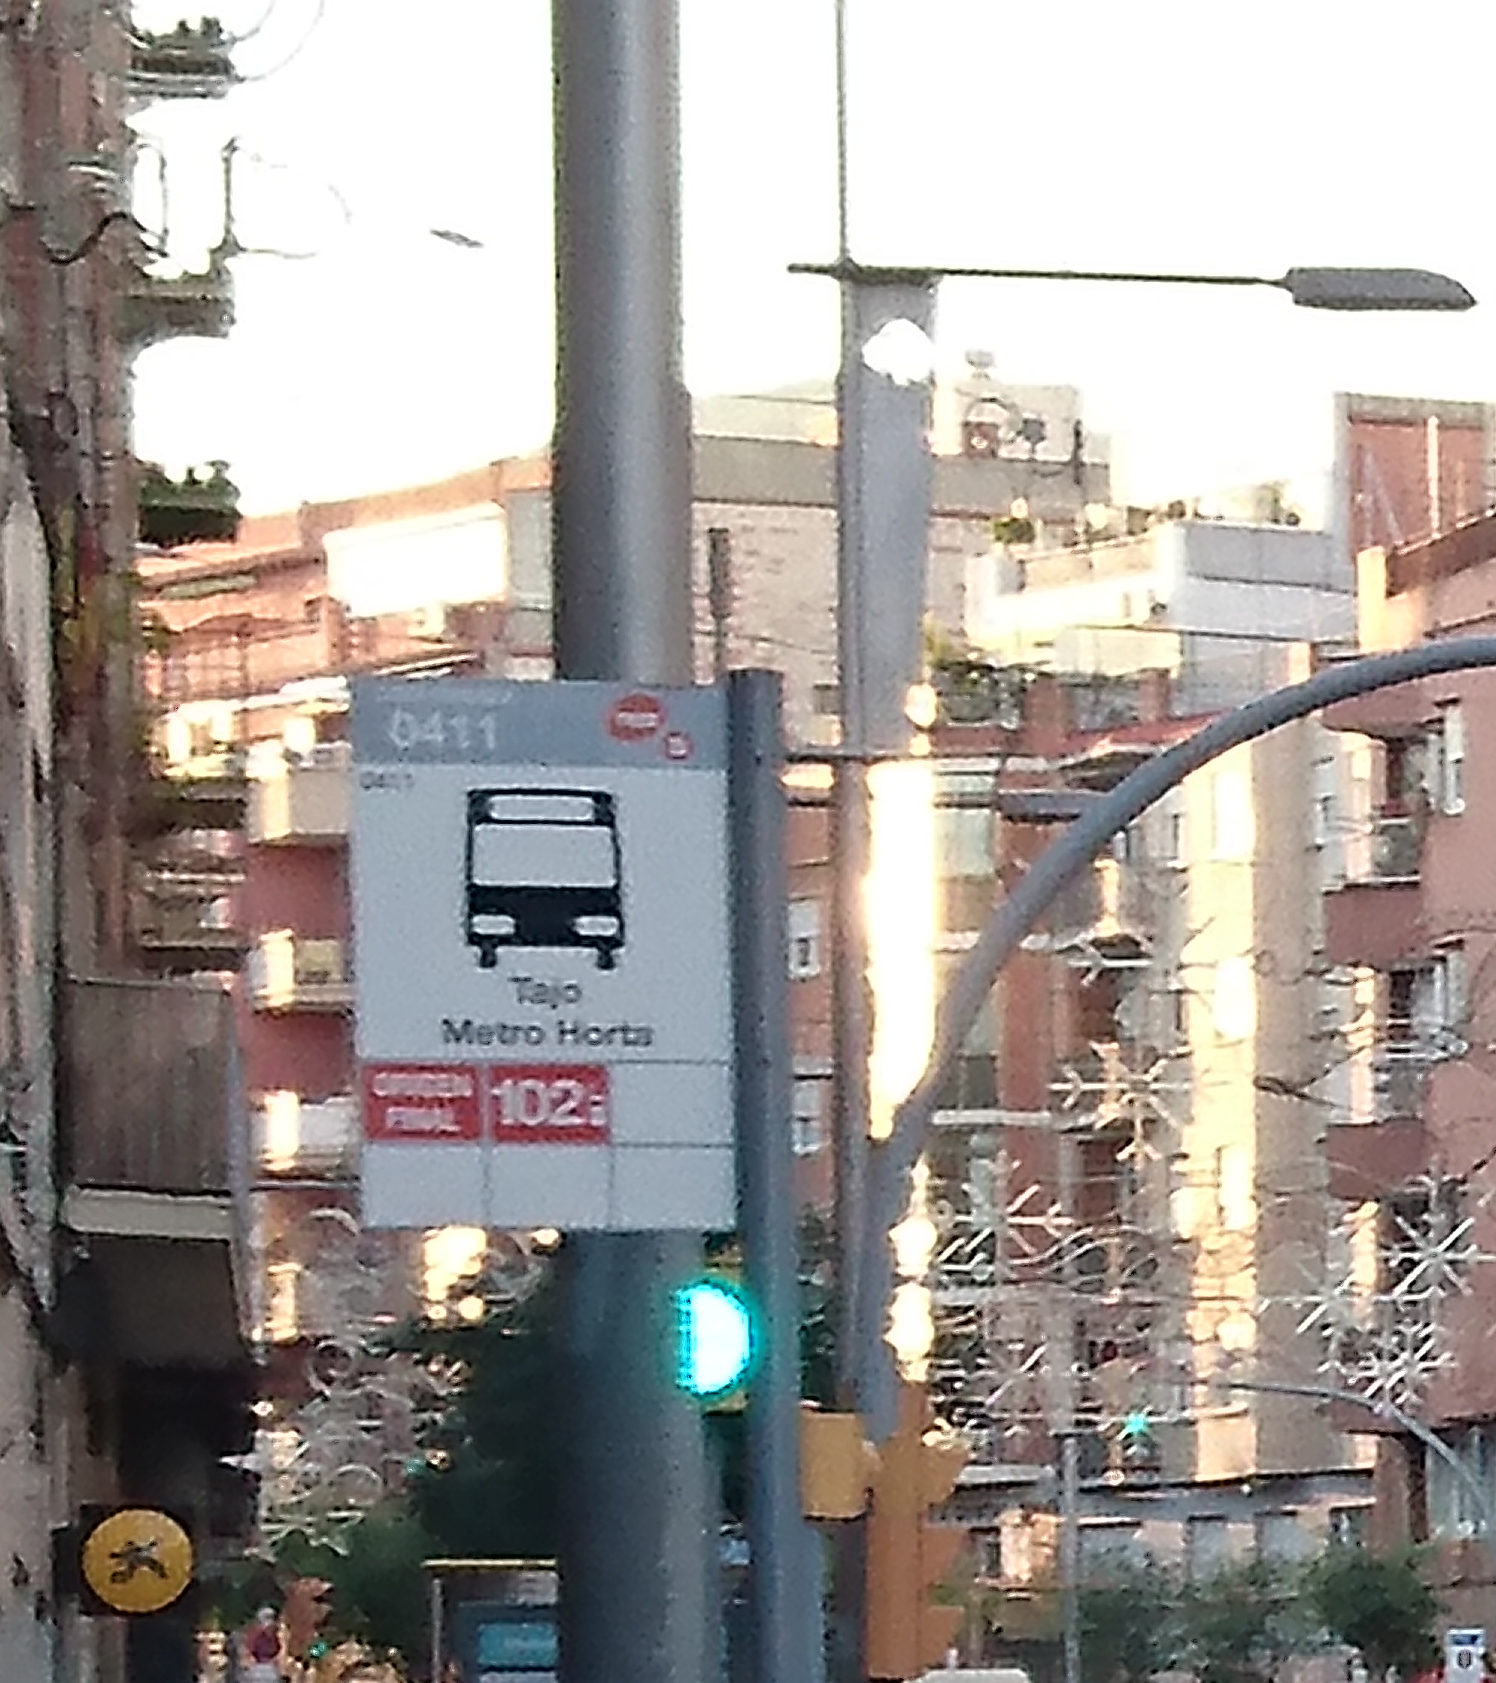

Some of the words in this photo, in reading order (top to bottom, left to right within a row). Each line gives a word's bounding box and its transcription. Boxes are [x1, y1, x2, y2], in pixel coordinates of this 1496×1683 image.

[507, 976, 582, 1010] Tajo
[442, 1018, 545, 1046] Metro
[557, 1018, 653, 1046] Horta
